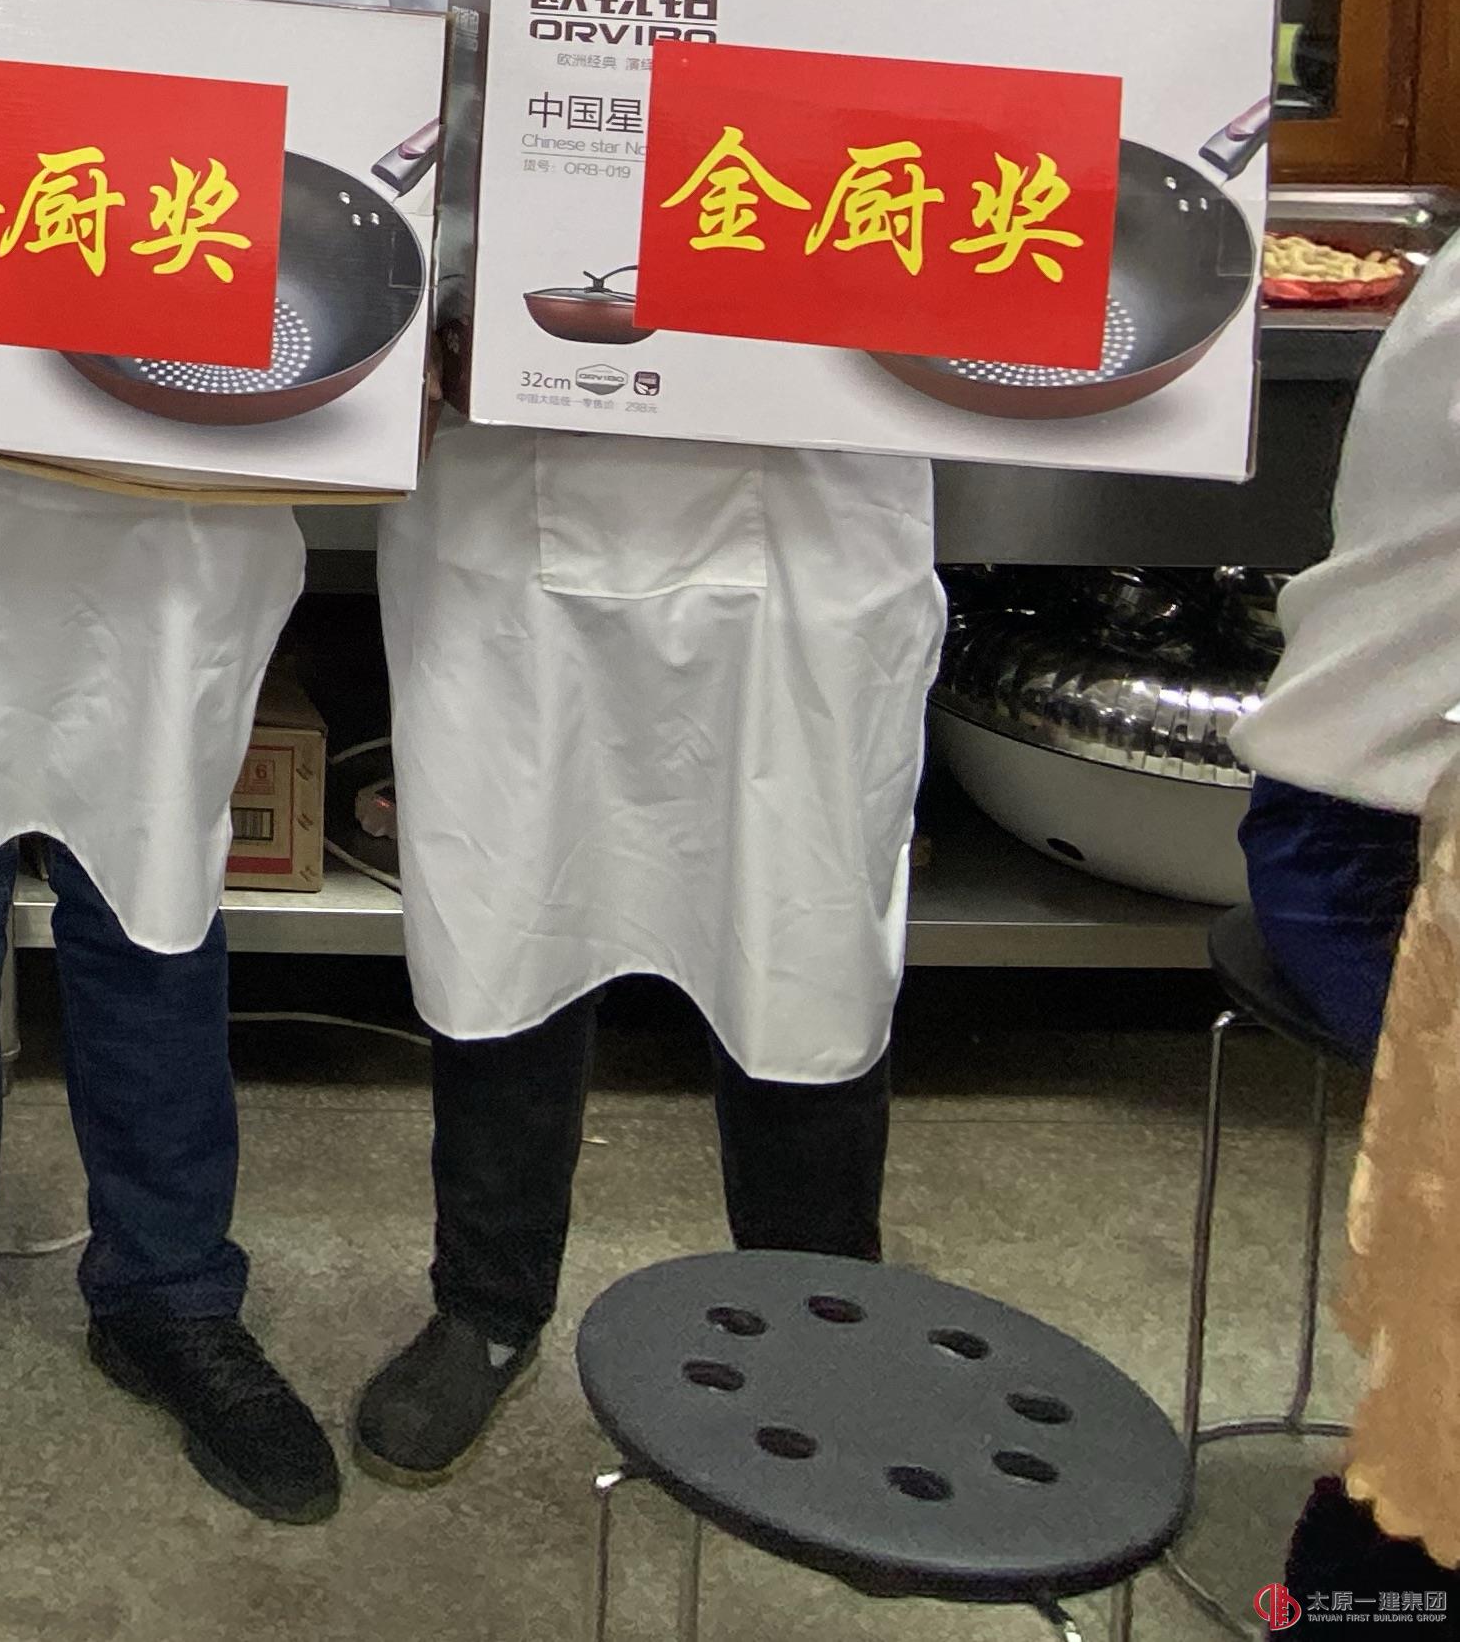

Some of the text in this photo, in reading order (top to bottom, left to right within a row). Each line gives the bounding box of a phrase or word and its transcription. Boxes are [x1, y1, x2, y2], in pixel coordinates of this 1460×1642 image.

[557, 53, 617, 69] 欧洲经典
[529, 91, 644, 133] 中国星
[522, 134, 585, 151] Chinese
[591, 139, 620, 154] star
[660, 126, 1083, 283] 金厨奖
[521, 371, 571, 390] 32cm
